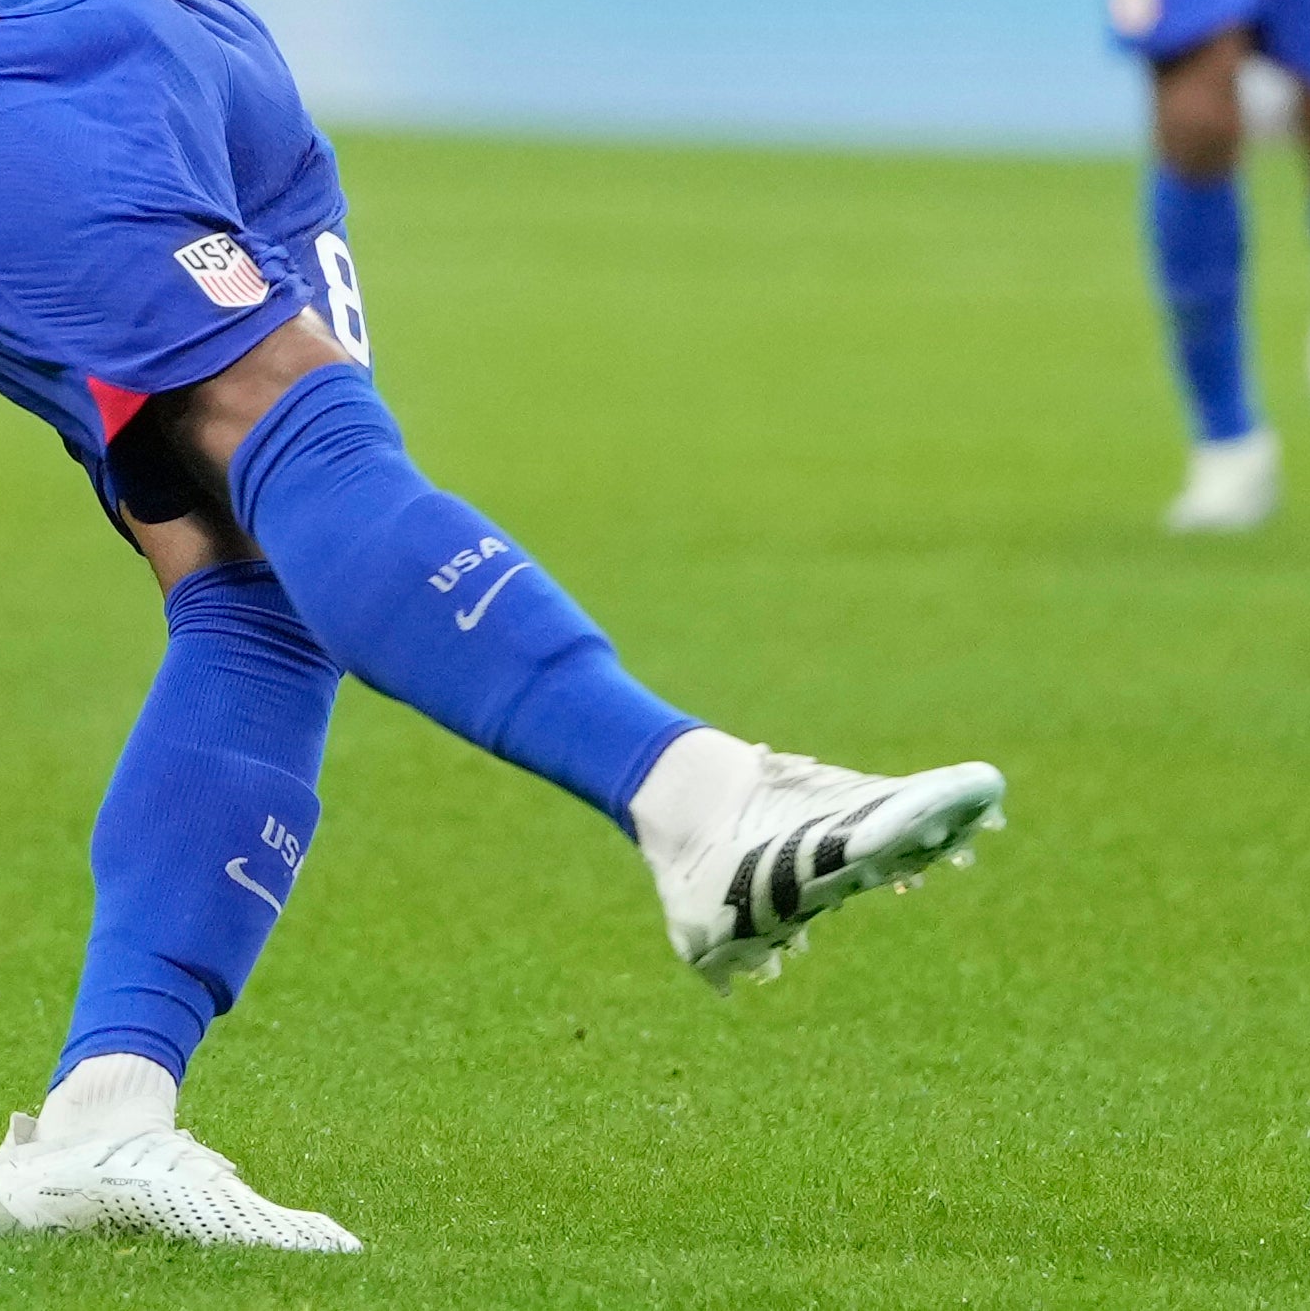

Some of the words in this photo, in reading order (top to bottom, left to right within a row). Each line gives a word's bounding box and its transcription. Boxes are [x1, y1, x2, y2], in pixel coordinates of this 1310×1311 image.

[181, 237, 238, 271] USA
[314, 230, 370, 369] 8
[427, 536, 511, 594] USA
[100, 1177, 152, 1188] PREDATOR
